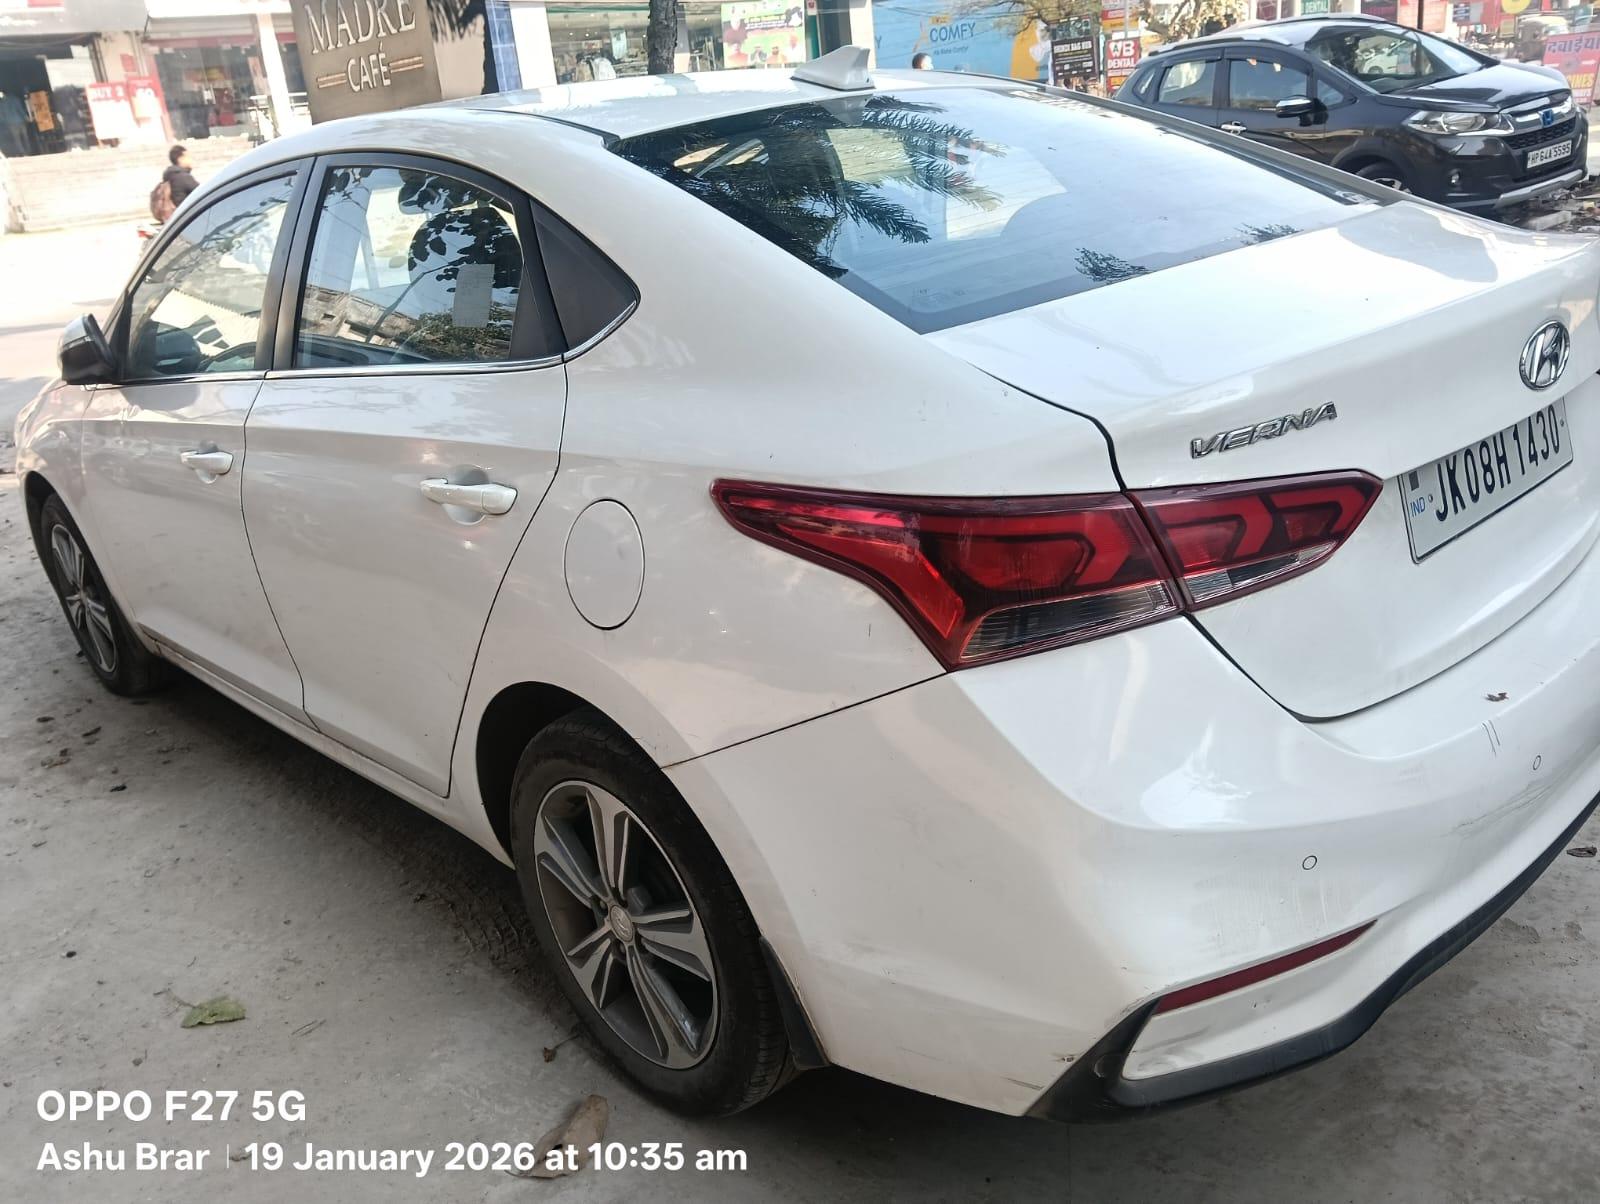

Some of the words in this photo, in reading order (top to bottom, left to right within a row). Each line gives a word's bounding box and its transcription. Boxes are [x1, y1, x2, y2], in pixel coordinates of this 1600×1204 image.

[304, 0, 416, 54] MADRE
[929, 22, 976, 42] COMFY
[347, 41, 391, 92] CAFÉ
[1107, 57, 1135, 69] DENTAL
[1190, 400, 1338, 459] VERNA
[1435, 431, 1511, 522] JK08H
[1512, 403, 1560, 476] 1430
[1410, 495, 1426, 518] IND
